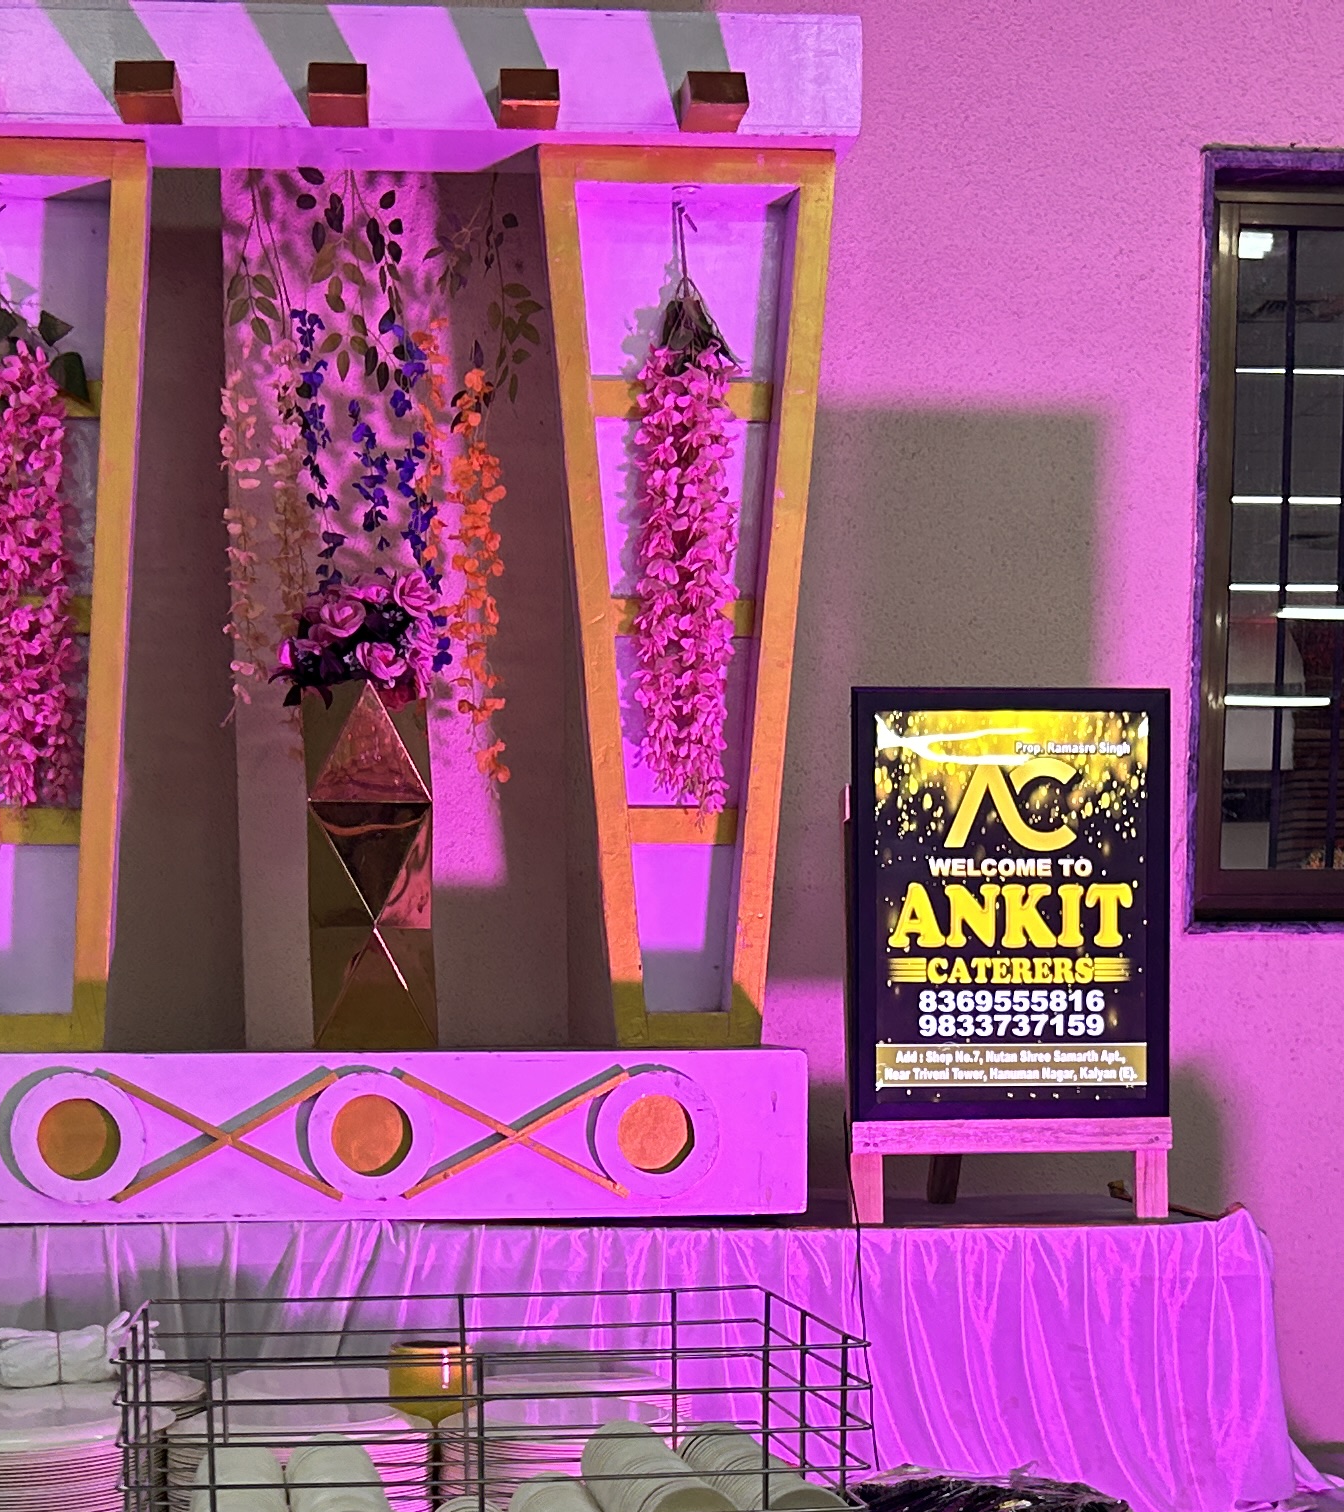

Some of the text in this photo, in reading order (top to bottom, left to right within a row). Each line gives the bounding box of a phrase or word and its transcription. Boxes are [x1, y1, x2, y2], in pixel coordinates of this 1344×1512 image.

[1015, 741, 1131, 757] Prop. Ramasre Singh
[929, 858, 1092, 877] WELCOME TO
[888, 882, 1133, 948] ANKIT
[926, 957, 1095, 984] CATERERS
[919, 990, 1105, 1013] 8369555816
[919, 1014, 1105, 1037] 9833737159
